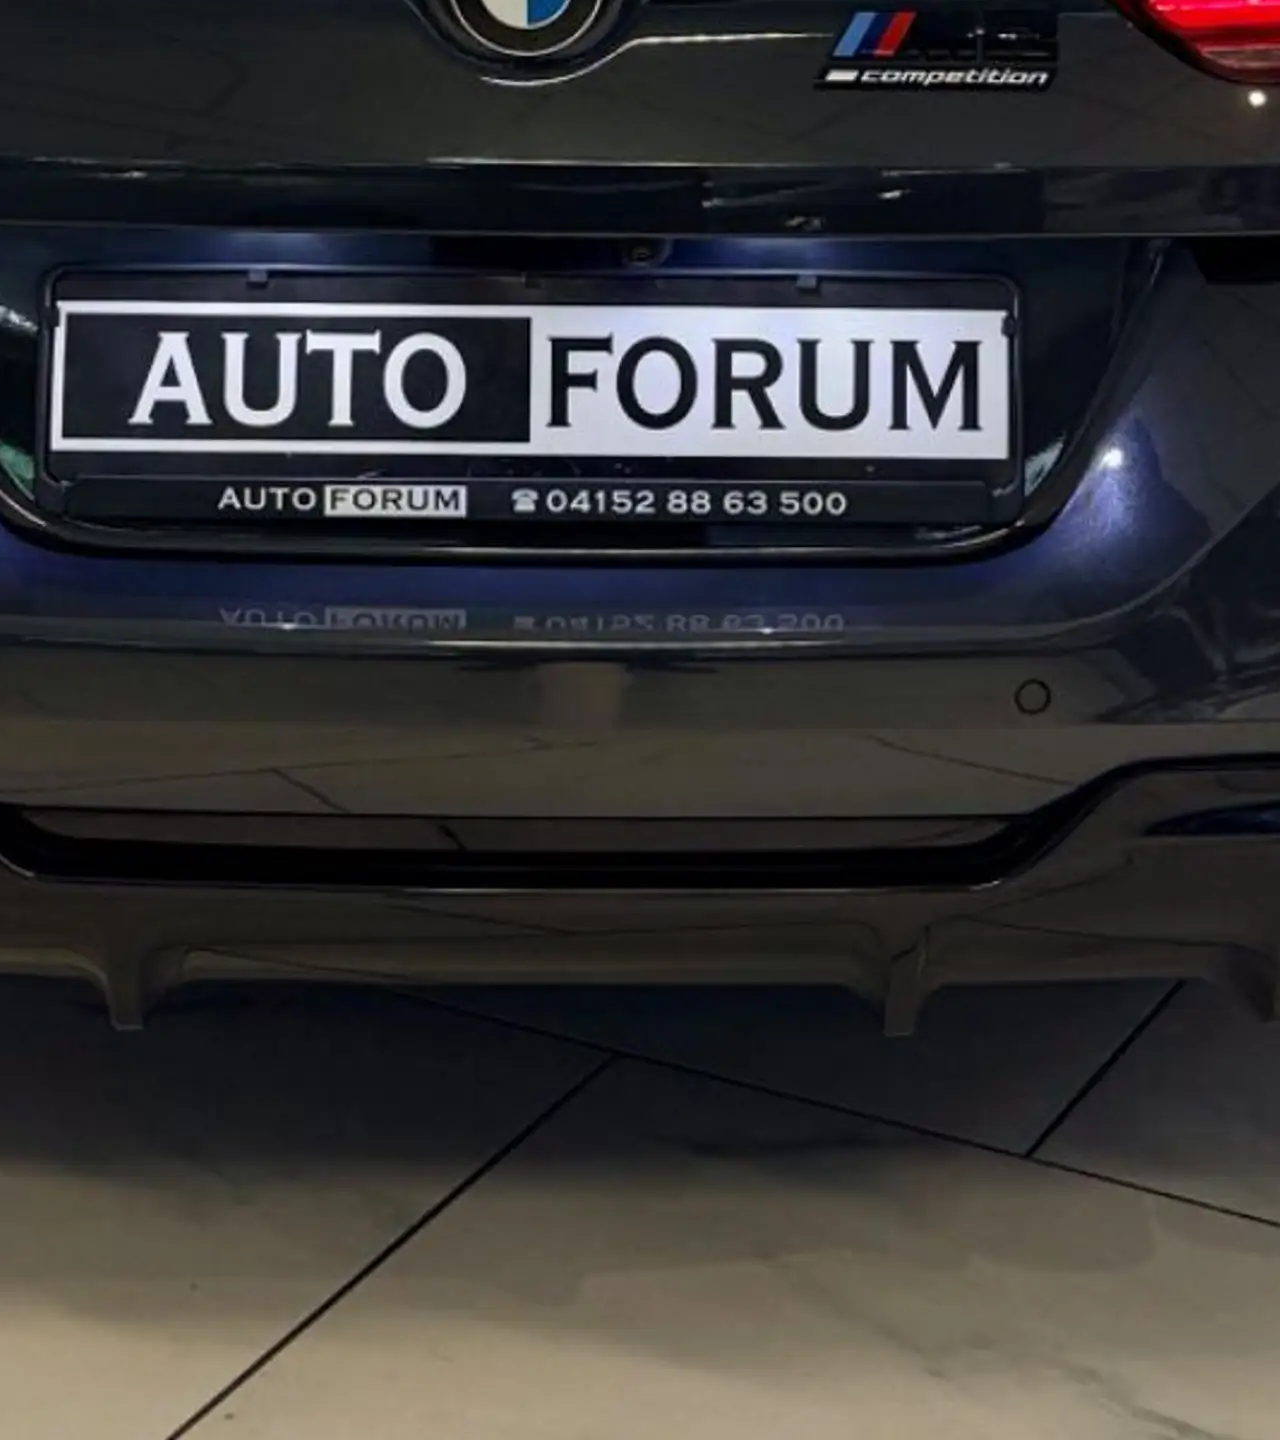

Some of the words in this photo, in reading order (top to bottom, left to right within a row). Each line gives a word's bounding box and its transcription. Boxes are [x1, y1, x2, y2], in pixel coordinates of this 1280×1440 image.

[860, 67, 1050, 86] competition
[127, 329, 467, 428] AUTO
[545, 333, 983, 431] FORUM
[218, 486, 317, 510] AUTO
[329, 487, 462, 511] FORUM
[545, 489, 656, 514] 04152
[666, 491, 712, 515] 88
[723, 491, 769, 515] 63
[779, 491, 848, 516] 500
